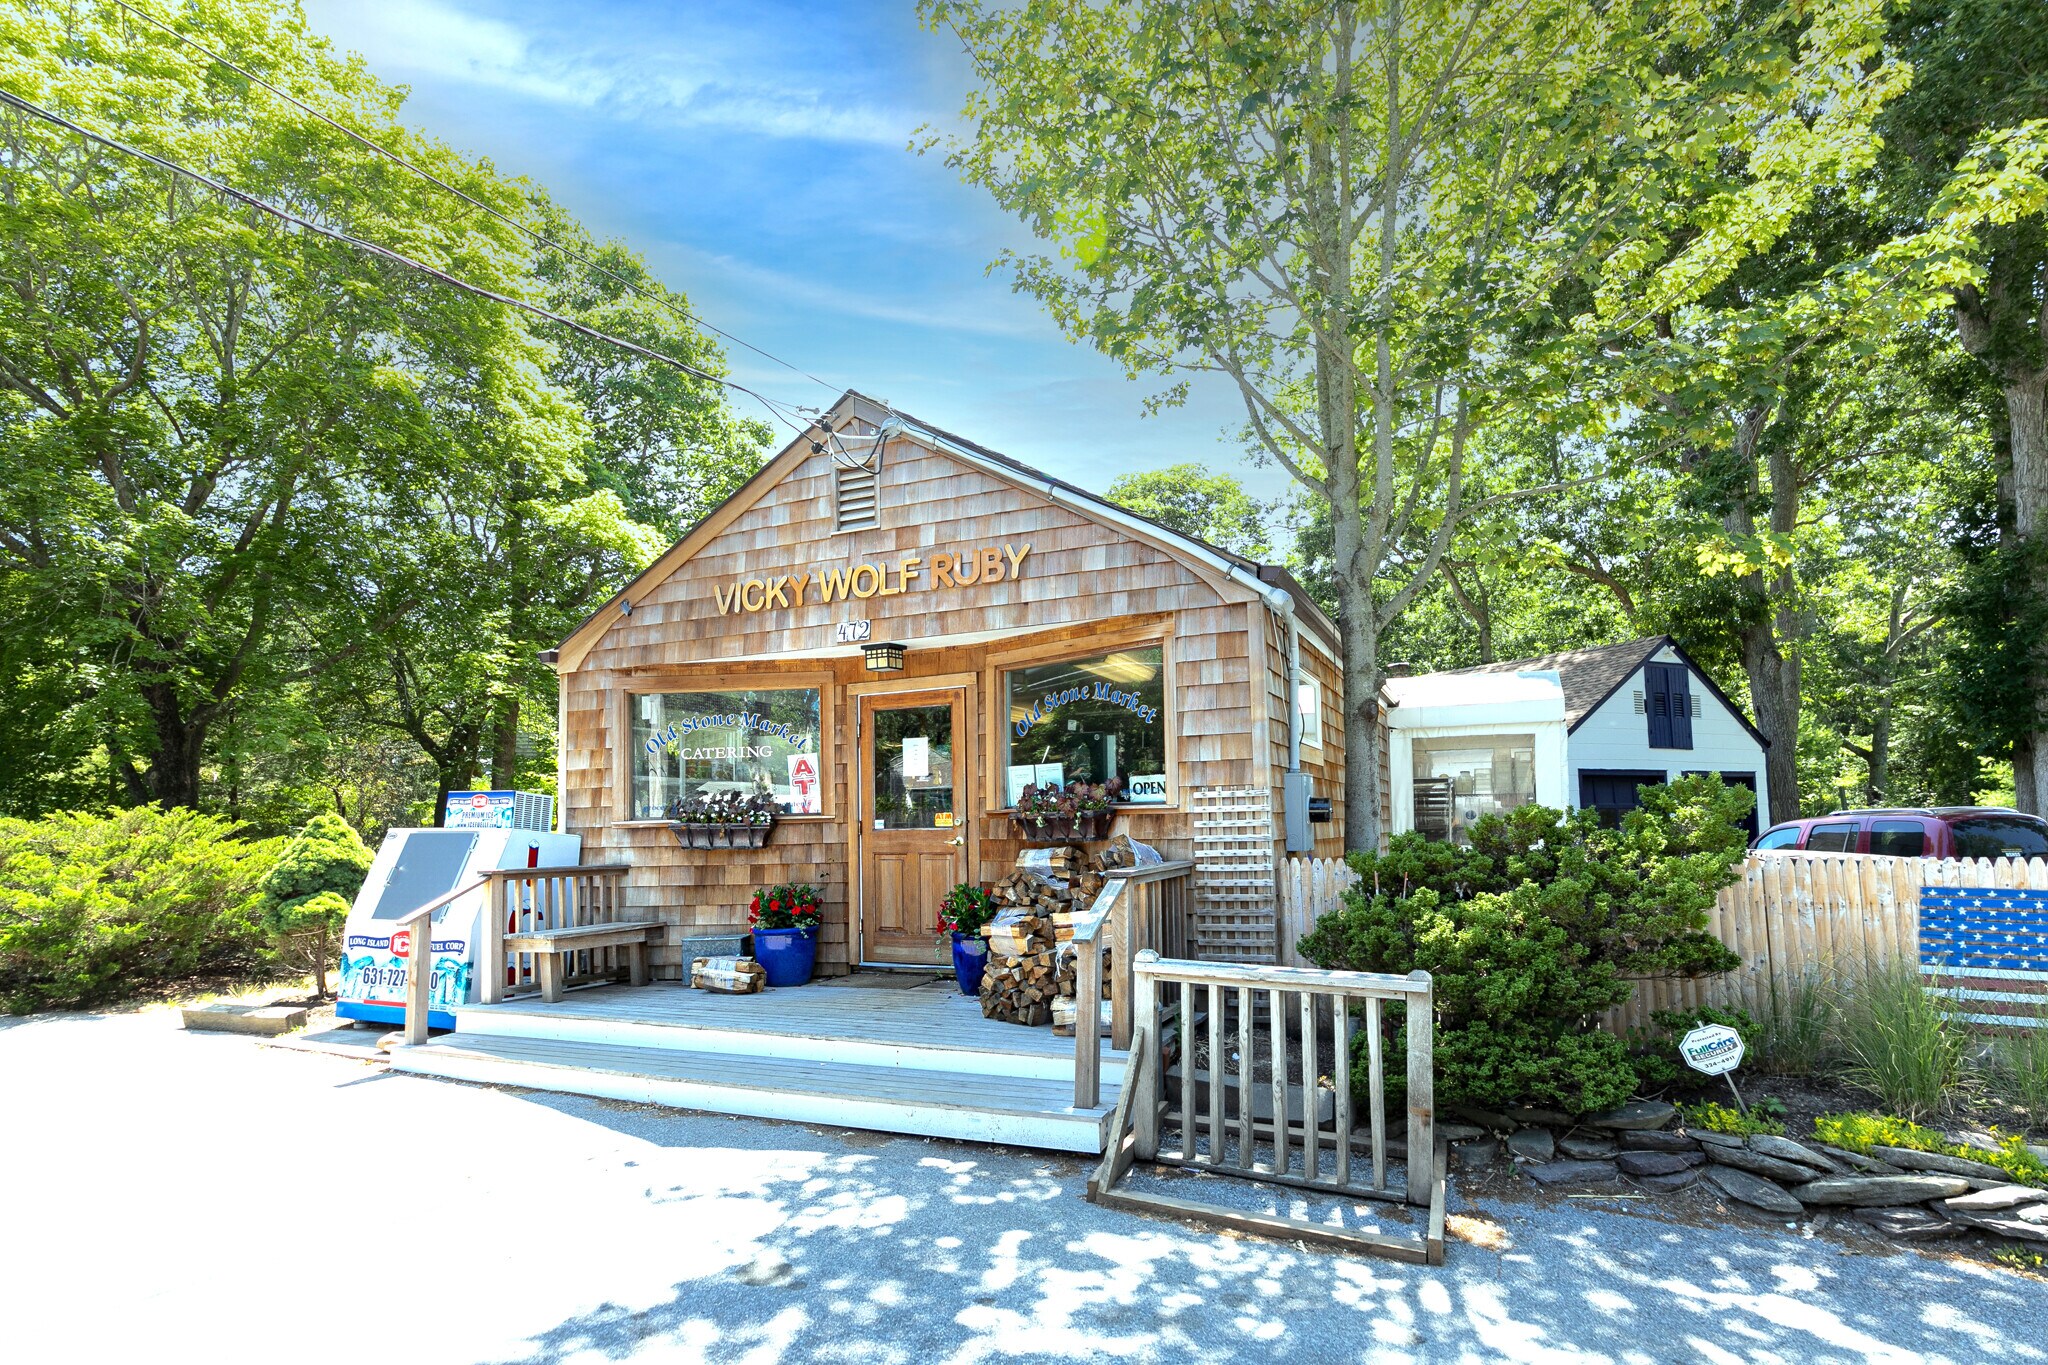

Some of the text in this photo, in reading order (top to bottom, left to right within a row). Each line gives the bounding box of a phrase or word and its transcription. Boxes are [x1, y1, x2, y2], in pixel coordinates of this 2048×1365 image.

[713, 543, 1032, 615] VICKY WOLF RUBY
[838, 621, 870, 641] 472
[1015, 681, 1157, 737] Old Stone Market
[645, 711, 810, 754] Old Stone Market
[680, 745, 773, 760] CATERING
[1132, 780, 1166, 796] OPEN
[349, 937, 366, 947] LONG
[366, 938, 389, 947] ISLAND
[392, 935, 410, 953] IC
[1687, 1036, 1735, 1055] FullCare
[1695, 1043, 1734, 1060] SECURITY
